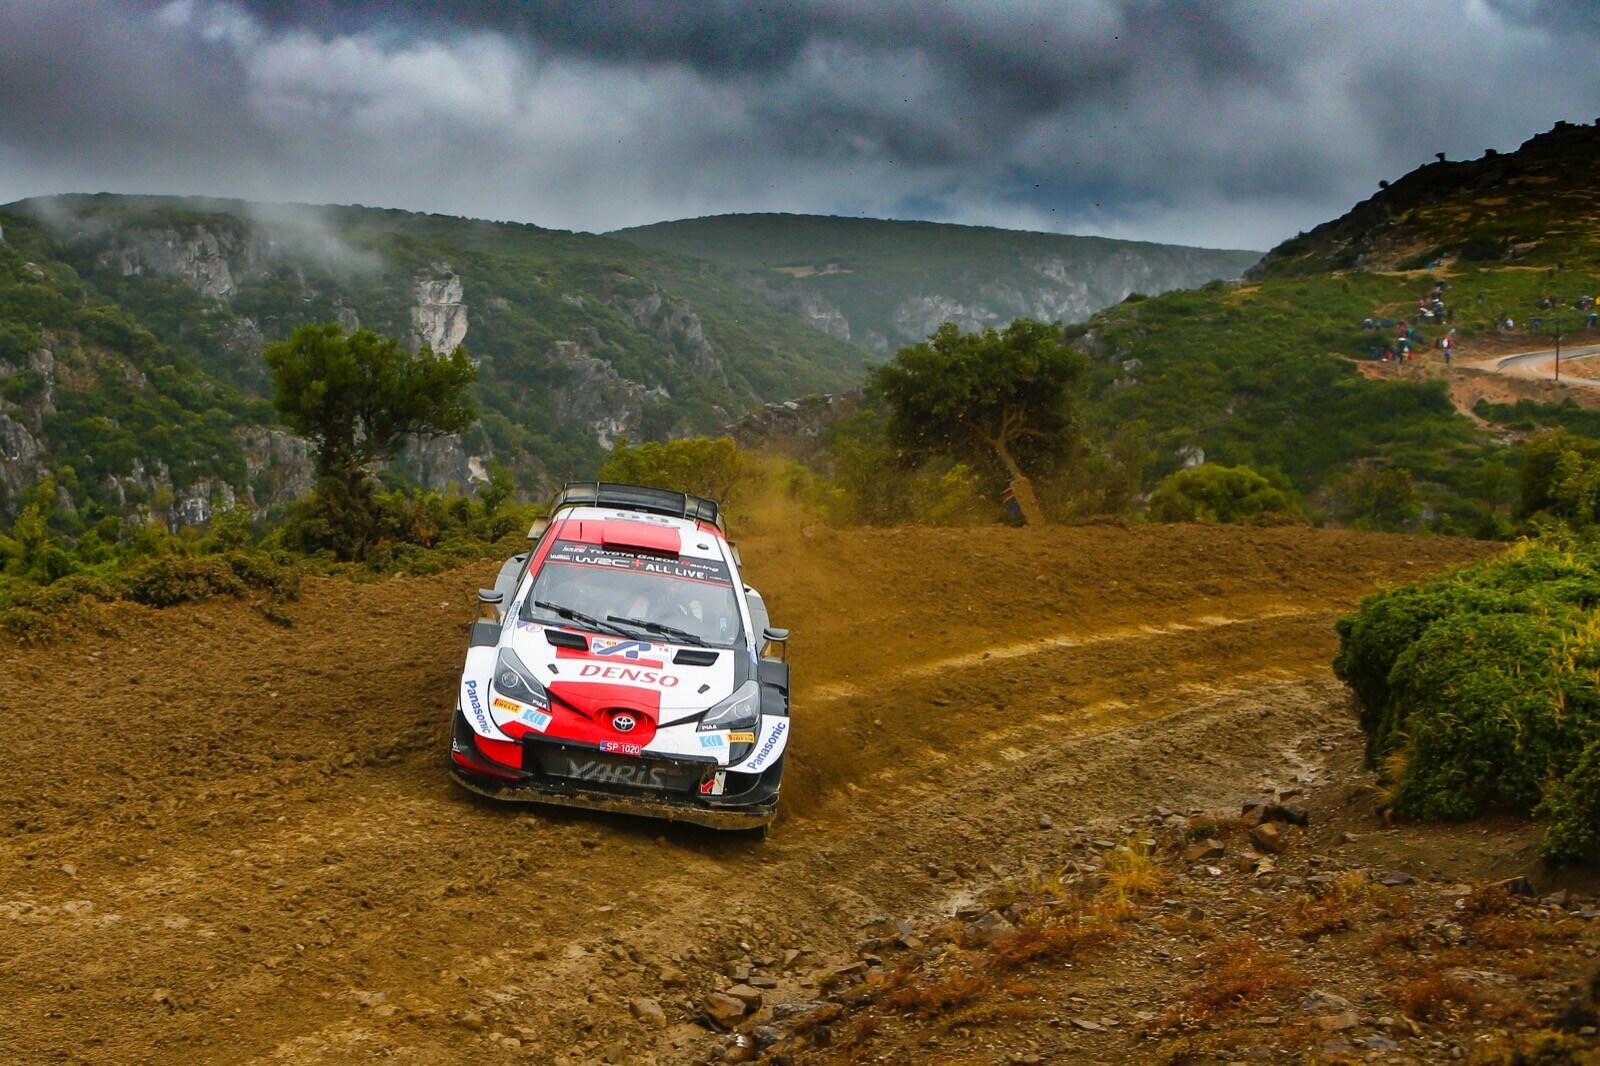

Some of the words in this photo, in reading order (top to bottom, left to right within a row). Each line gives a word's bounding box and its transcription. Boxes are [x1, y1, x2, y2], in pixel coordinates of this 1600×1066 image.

[589, 548, 635, 558] TOYOTA
[681, 560, 720, 573] Racing
[645, 563, 672, 574] ALL
[675, 567, 705, 580] LIVE
[579, 664, 679, 687] DENSO
[465, 680, 491, 734] Panasonic
[494, 698, 520, 713] PIRELLI
[606, 742, 619, 751] SP
[621, 744, 640, 754] 1020
[746, 722, 786, 770] Panasonic
